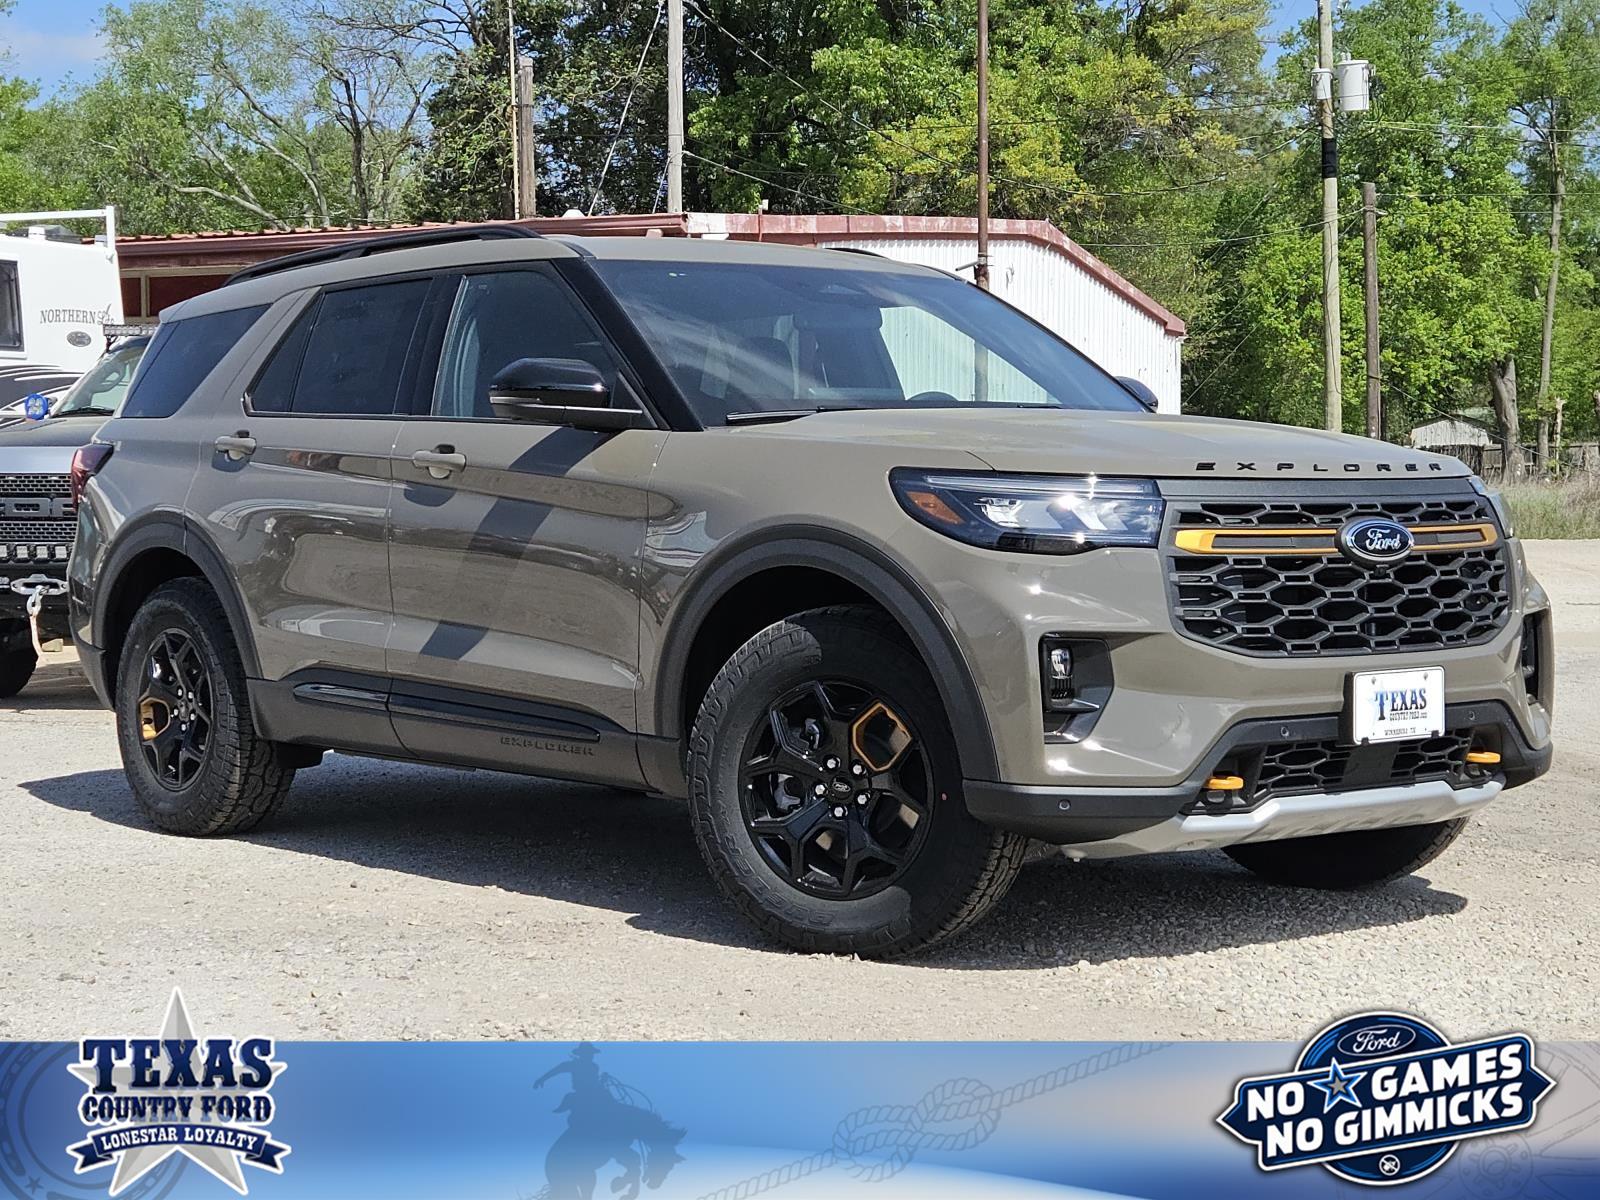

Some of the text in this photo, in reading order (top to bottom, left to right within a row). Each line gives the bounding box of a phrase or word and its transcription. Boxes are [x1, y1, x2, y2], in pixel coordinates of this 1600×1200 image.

[40, 308, 96, 324] NORTHERN
[1195, 461, 1442, 472] EXPLORER
[1365, 528, 1401, 551] Ford
[1374, 688, 1427, 721] TEXAS
[500, 736, 595, 756] EXPLORER
